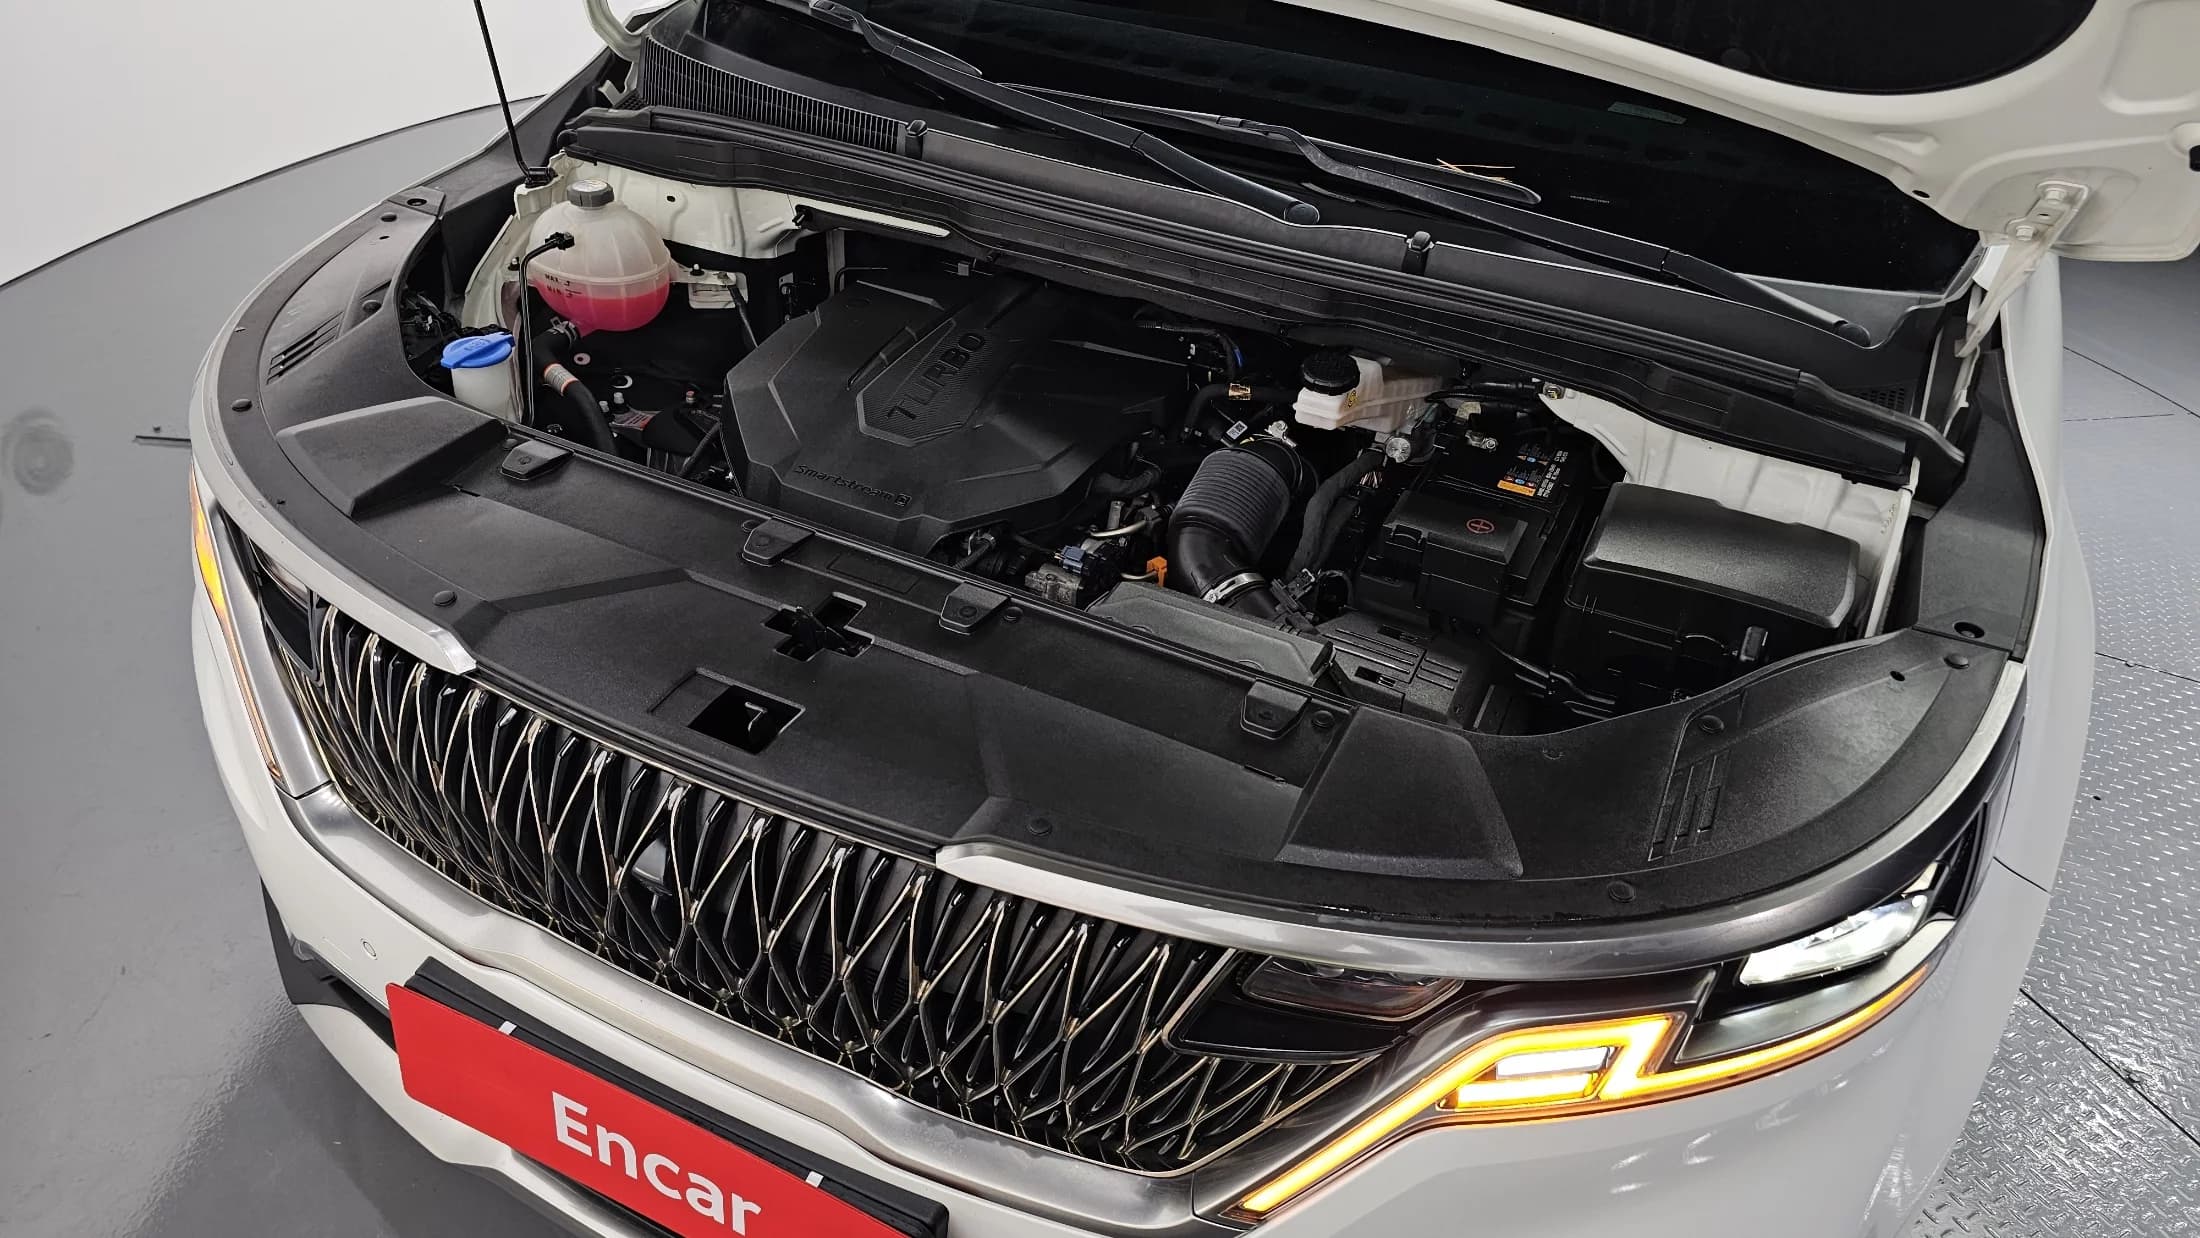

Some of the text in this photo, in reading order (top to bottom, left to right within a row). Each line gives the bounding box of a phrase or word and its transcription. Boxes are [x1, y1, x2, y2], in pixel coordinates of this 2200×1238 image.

[885, 331, 986, 421] TURBO
[794, 463, 896, 501] Smartstream
[552, 1090, 762, 1236] Encar
